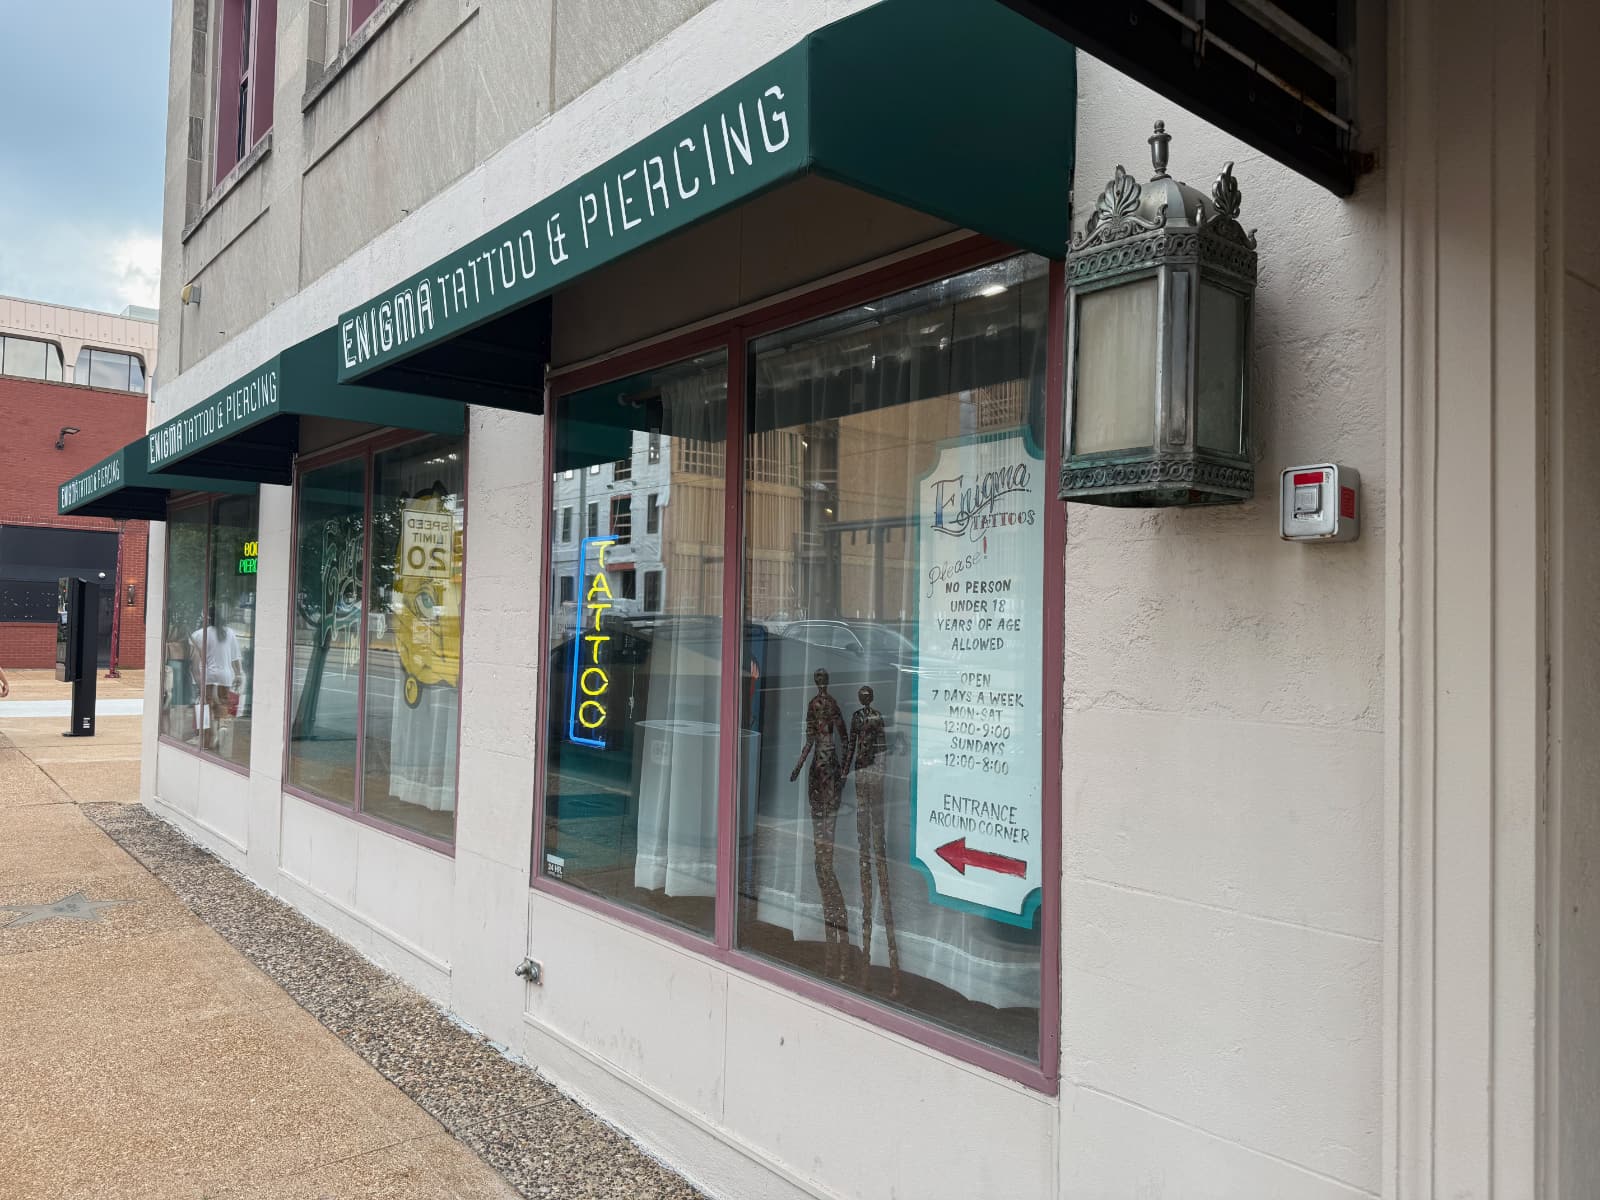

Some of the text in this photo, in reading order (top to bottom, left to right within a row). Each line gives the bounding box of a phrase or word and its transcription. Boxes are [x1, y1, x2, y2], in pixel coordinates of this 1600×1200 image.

[342, 85, 790, 369] ENIGMA TATTOO & PIERCING
[149, 371, 277, 465] ENIGMA TATTOO & PIERCING
[930, 462, 1032, 538] Enigma
[970, 509, 1036, 532] TATTOOS
[945, 579, 1012, 594] NO PERSON
[950, 599, 1006, 613] UNDER 18
[578, 540, 616, 729] TATTOO
[937, 618, 1021, 632] YEARS OF AGE
[951, 637, 1004, 651] ALLOWED
[960, 672, 991, 688] OPEN
[931, 689, 1024, 708] 7 DAYS A WEEK
[950, 736, 1005, 756] SUNDAYS
[943, 793, 1017, 826] ENTRANCE
[929, 809, 1031, 846] AROUND CORNER
